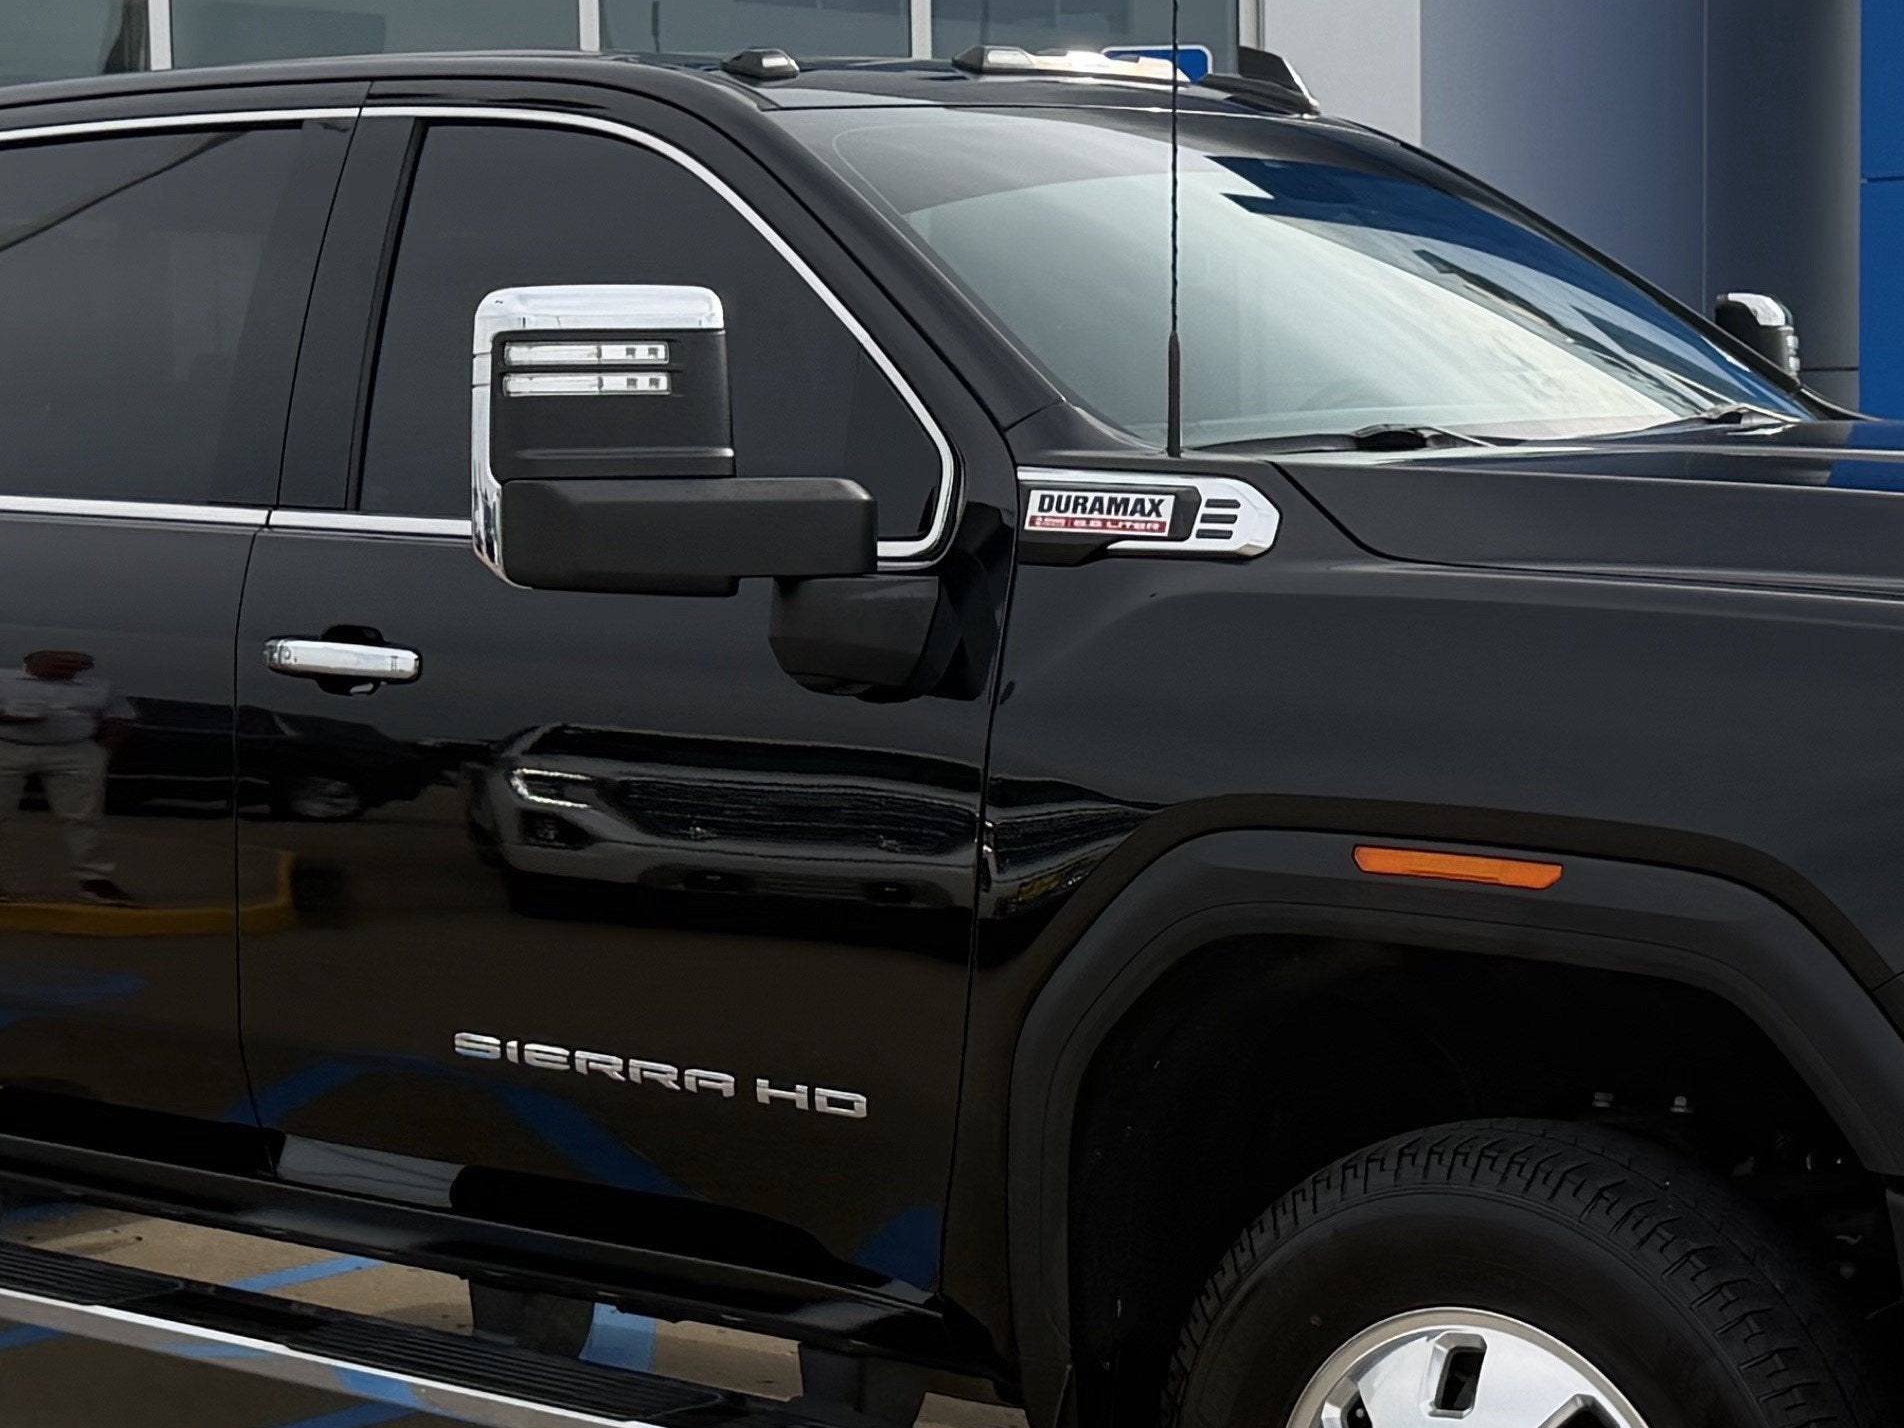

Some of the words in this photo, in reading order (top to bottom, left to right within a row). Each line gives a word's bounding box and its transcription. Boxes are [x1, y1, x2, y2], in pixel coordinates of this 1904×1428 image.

[1037, 493, 1165, 518] DURAMAX
[1106, 520, 1160, 531] LITER
[454, 1032, 735, 1099] SIERRA
[756, 1078, 868, 1119] HD
